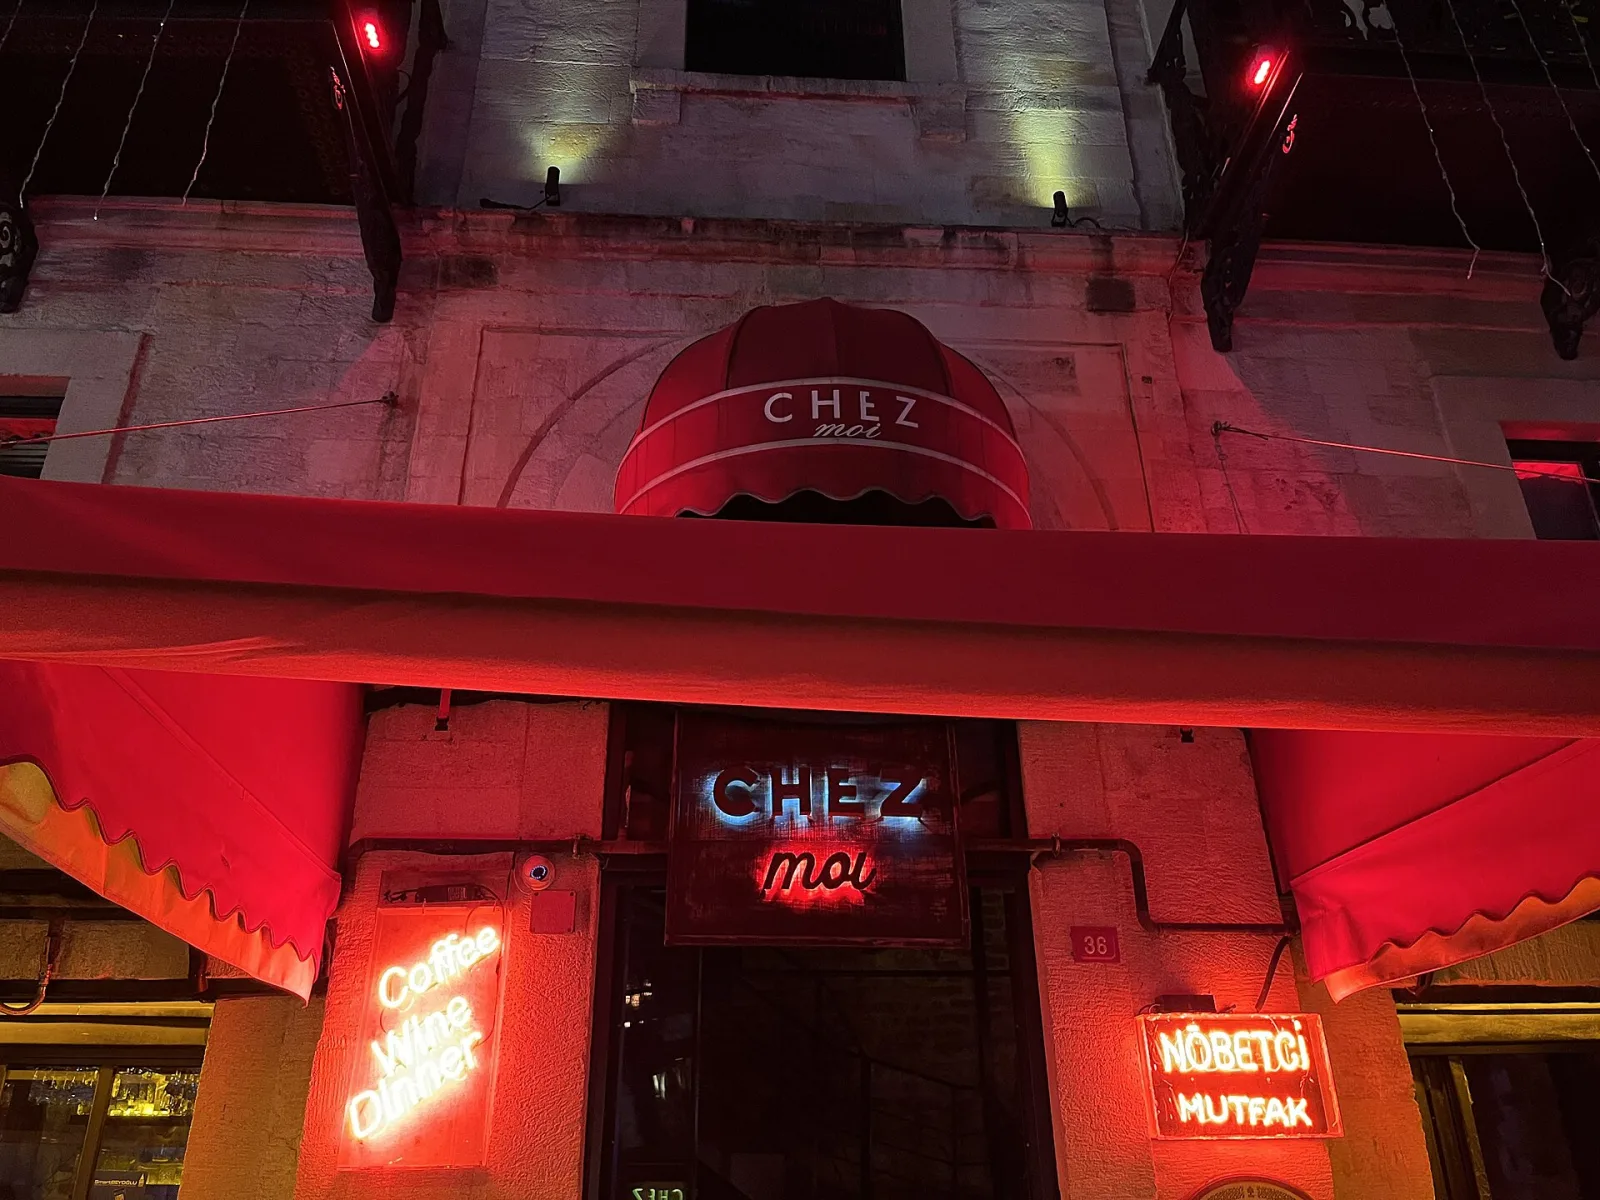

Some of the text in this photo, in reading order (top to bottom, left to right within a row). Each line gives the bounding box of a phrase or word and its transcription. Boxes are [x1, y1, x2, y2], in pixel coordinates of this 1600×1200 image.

[764, 389, 919, 428] CHEZ
[813, 423, 882, 438] moi
[713, 767, 927, 817] CHEZ
[762, 851, 877, 890] moi
[1084, 935, 1108, 955] 36
[378, 926, 501, 1008] Coffee
[371, 996, 471, 1077] Wine
[349, 1031, 482, 1138] Dinner
[1178, 1092, 1313, 1127] MUTFAK
